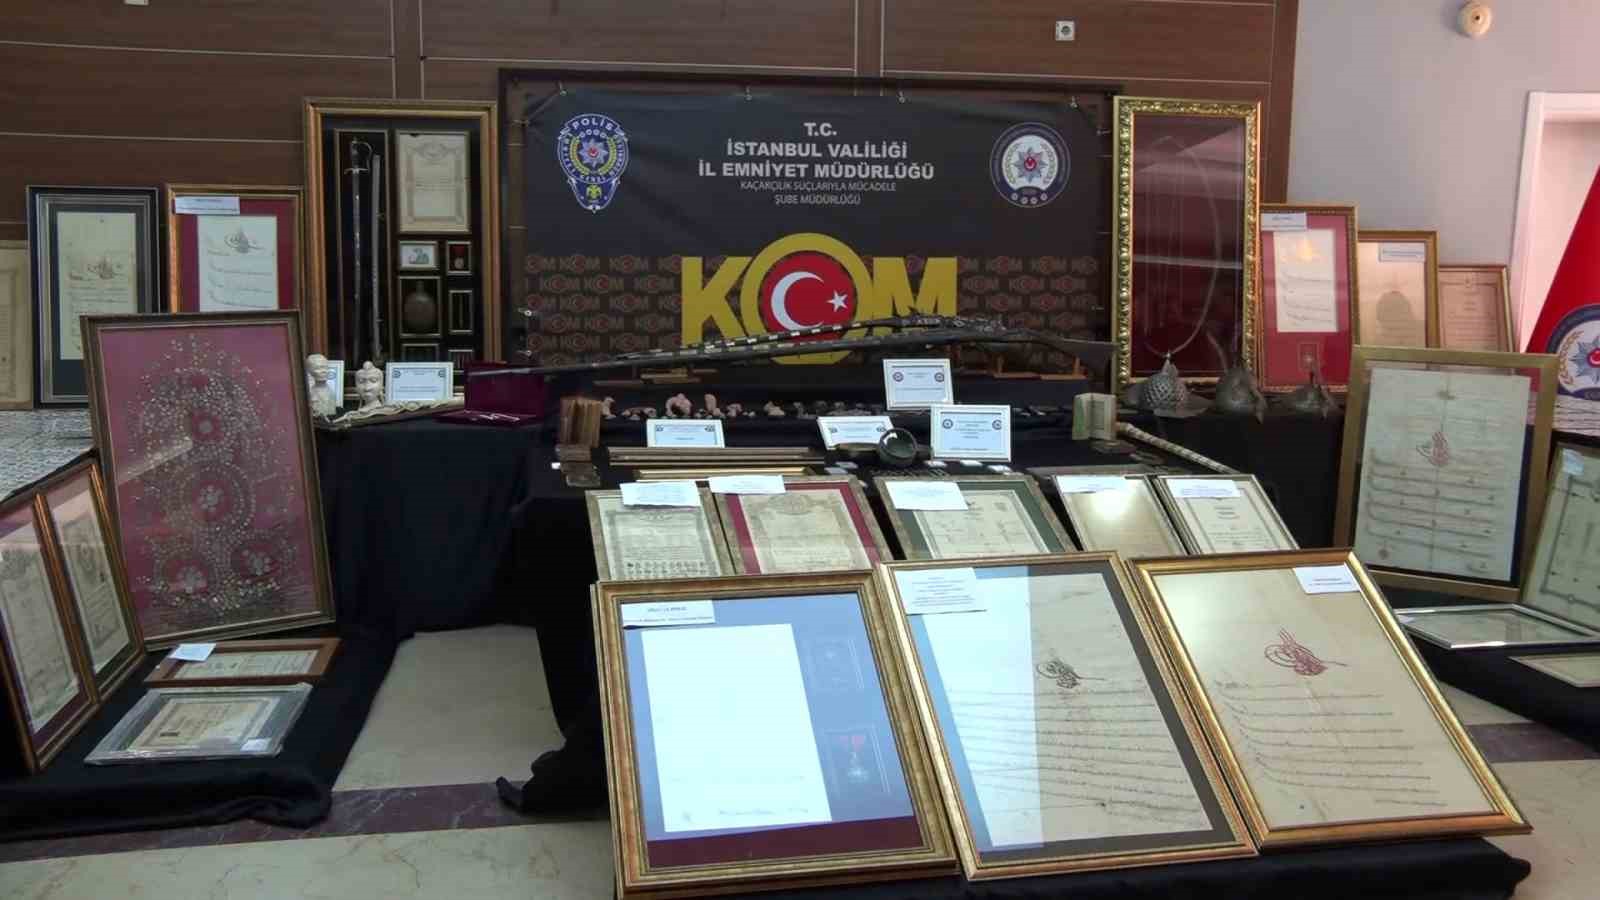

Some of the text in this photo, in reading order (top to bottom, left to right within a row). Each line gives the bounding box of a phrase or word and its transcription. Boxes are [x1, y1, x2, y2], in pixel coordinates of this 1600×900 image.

[803, 122, 837, 136] T.C.
[727, 138, 908, 158] İSTANBUL VALİLİĞİ
[699, 160, 934, 179] İL EMNİYET MÜDÜRLÜĞÜ
[848, 180, 896, 191] MÜCADELE
[775, 193, 861, 205] ŞUBE MÜDÜRLÜĞÜ
[681, 233, 957, 365] KOM
